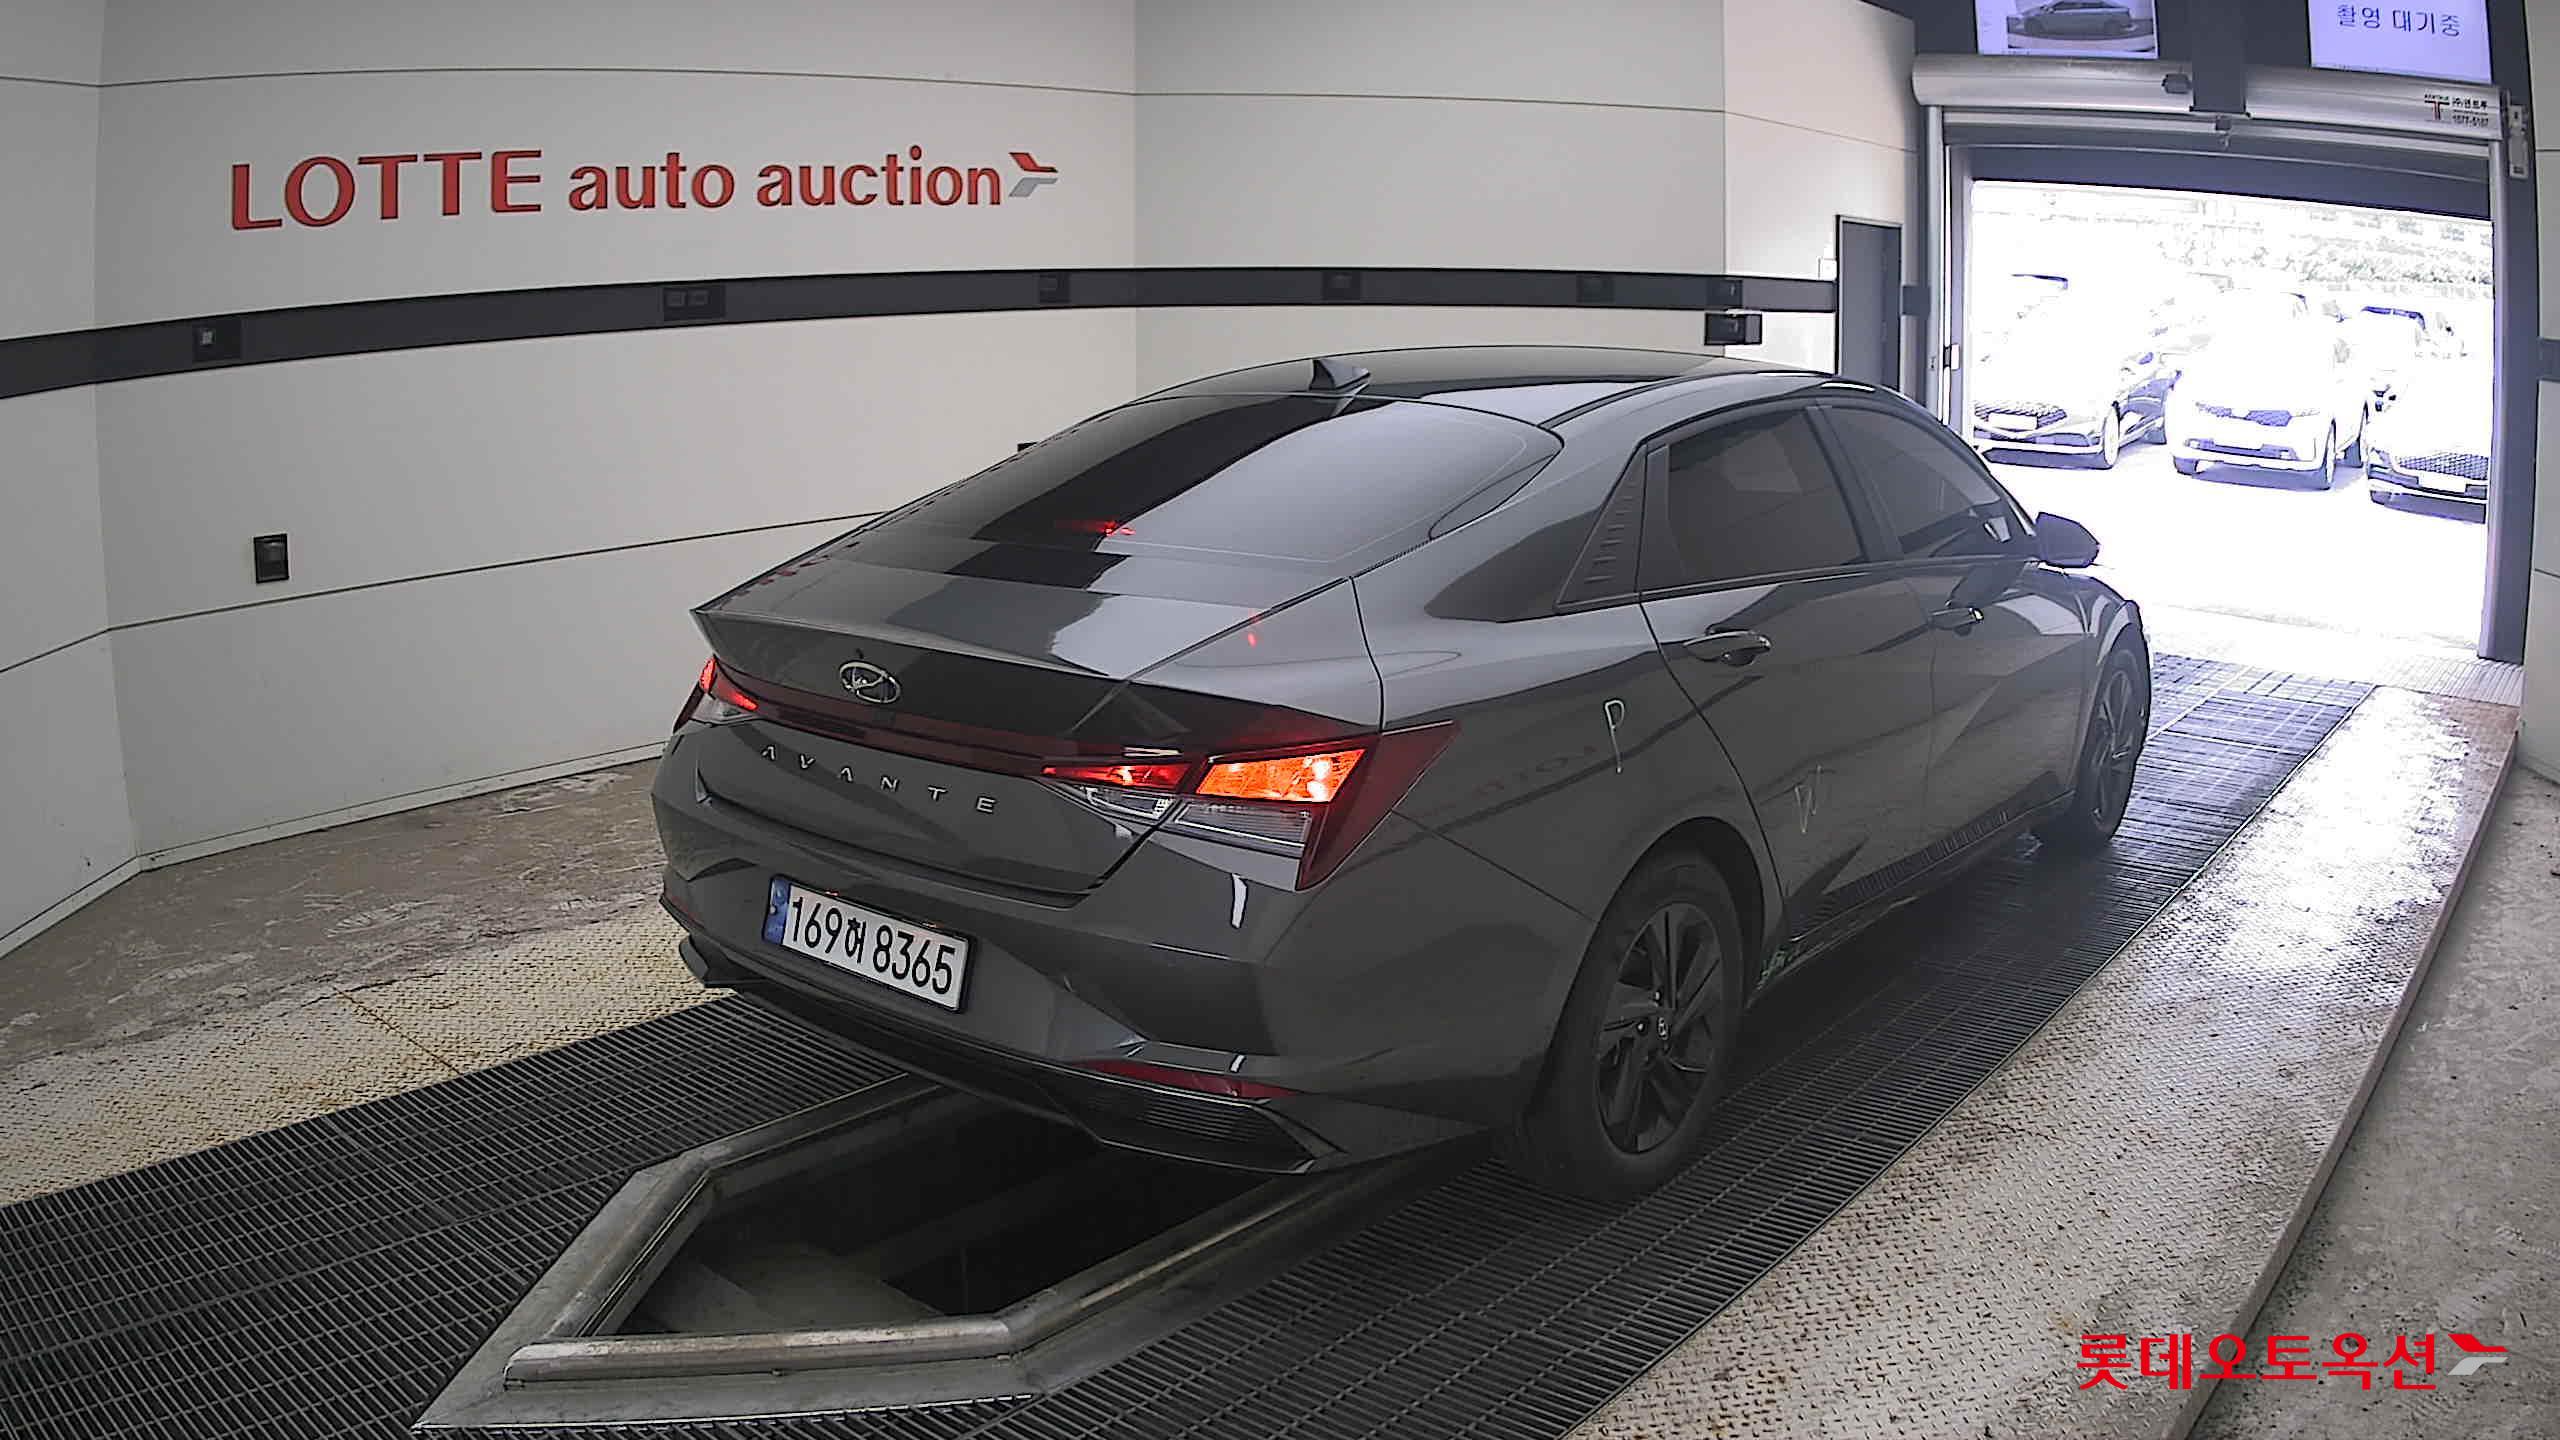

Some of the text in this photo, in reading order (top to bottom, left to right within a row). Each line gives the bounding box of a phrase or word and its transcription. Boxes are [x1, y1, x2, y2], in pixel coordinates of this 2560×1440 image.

[2337, 3, 2461, 38] 촬영 대기중
[232, 145, 1002, 231] LOTTE auto auction
[761, 744, 997, 814] AVANTE
[792, 896, 956, 995] 169허 8365
